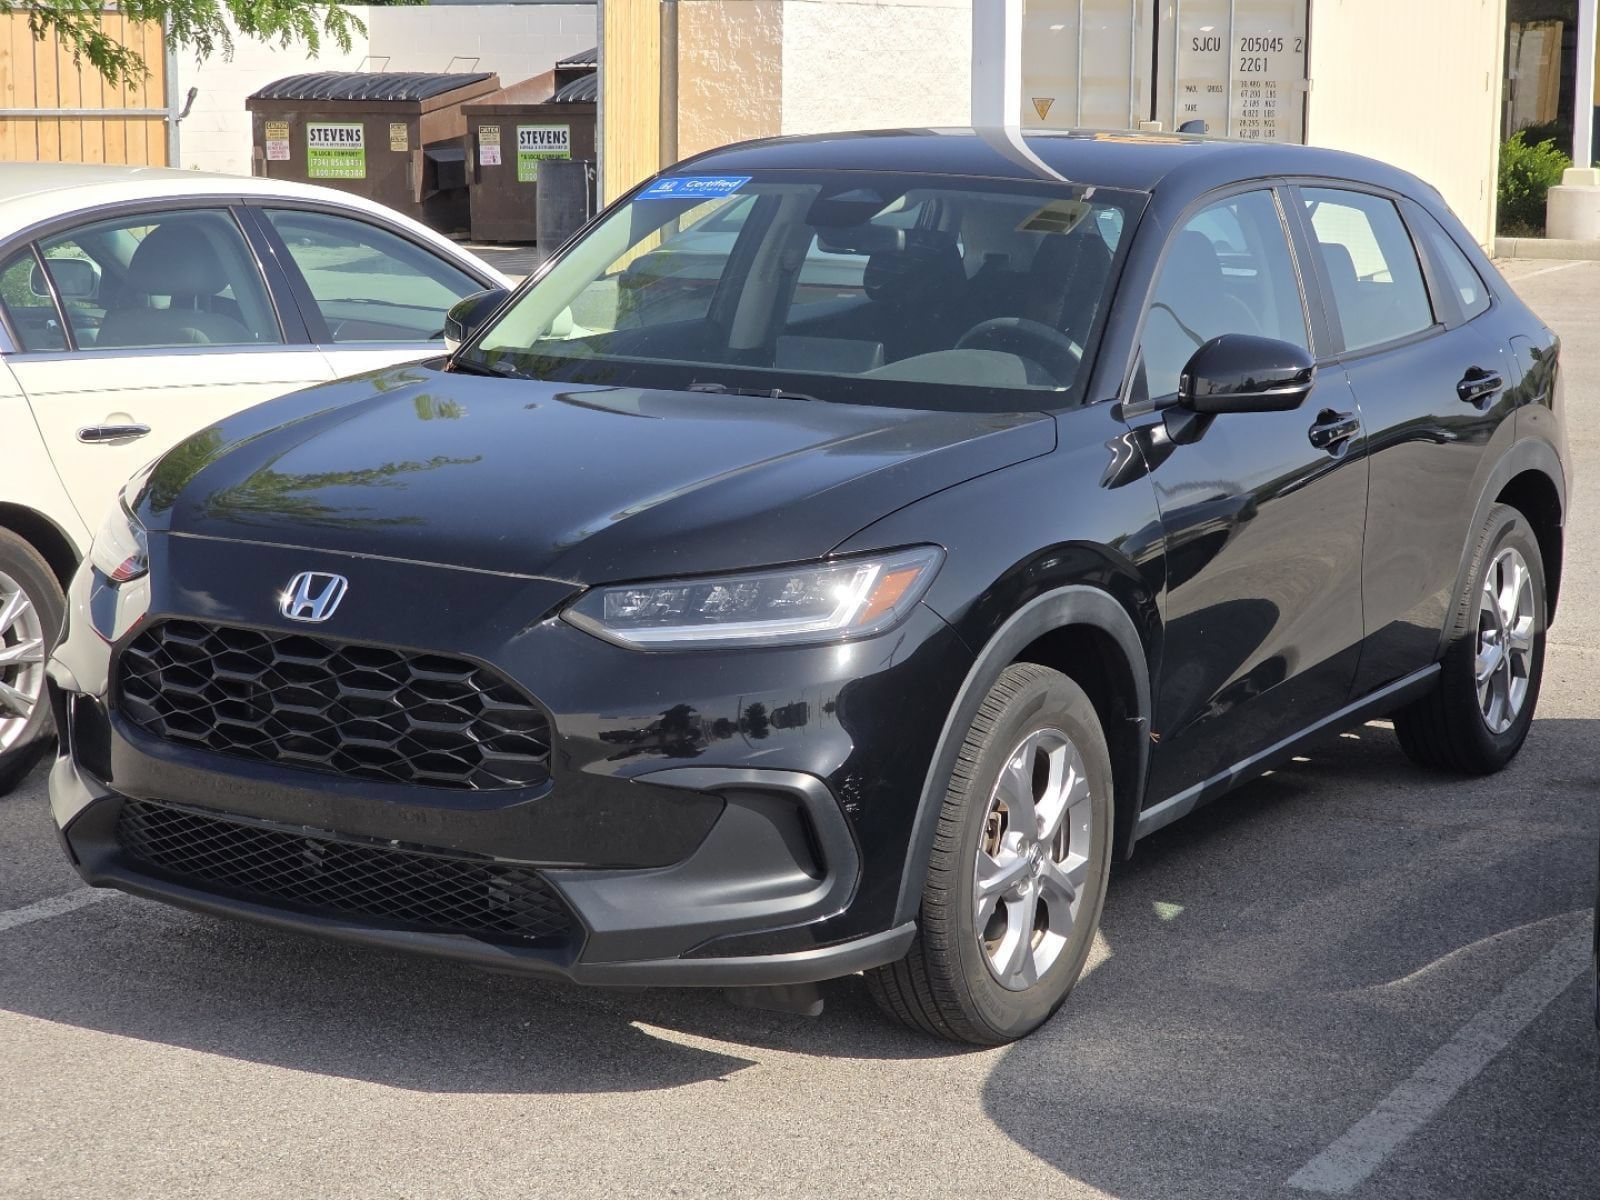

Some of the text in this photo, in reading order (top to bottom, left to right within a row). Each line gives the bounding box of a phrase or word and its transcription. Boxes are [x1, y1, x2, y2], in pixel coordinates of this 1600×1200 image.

[1192, 37, 1302, 53] SJCU 205045 2
[1240, 57, 1268, 72] 22G1
[310, 128, 361, 142] STEVENS
[520, 130, 567, 144] STEVENS
[686, 179, 742, 188] Certified
